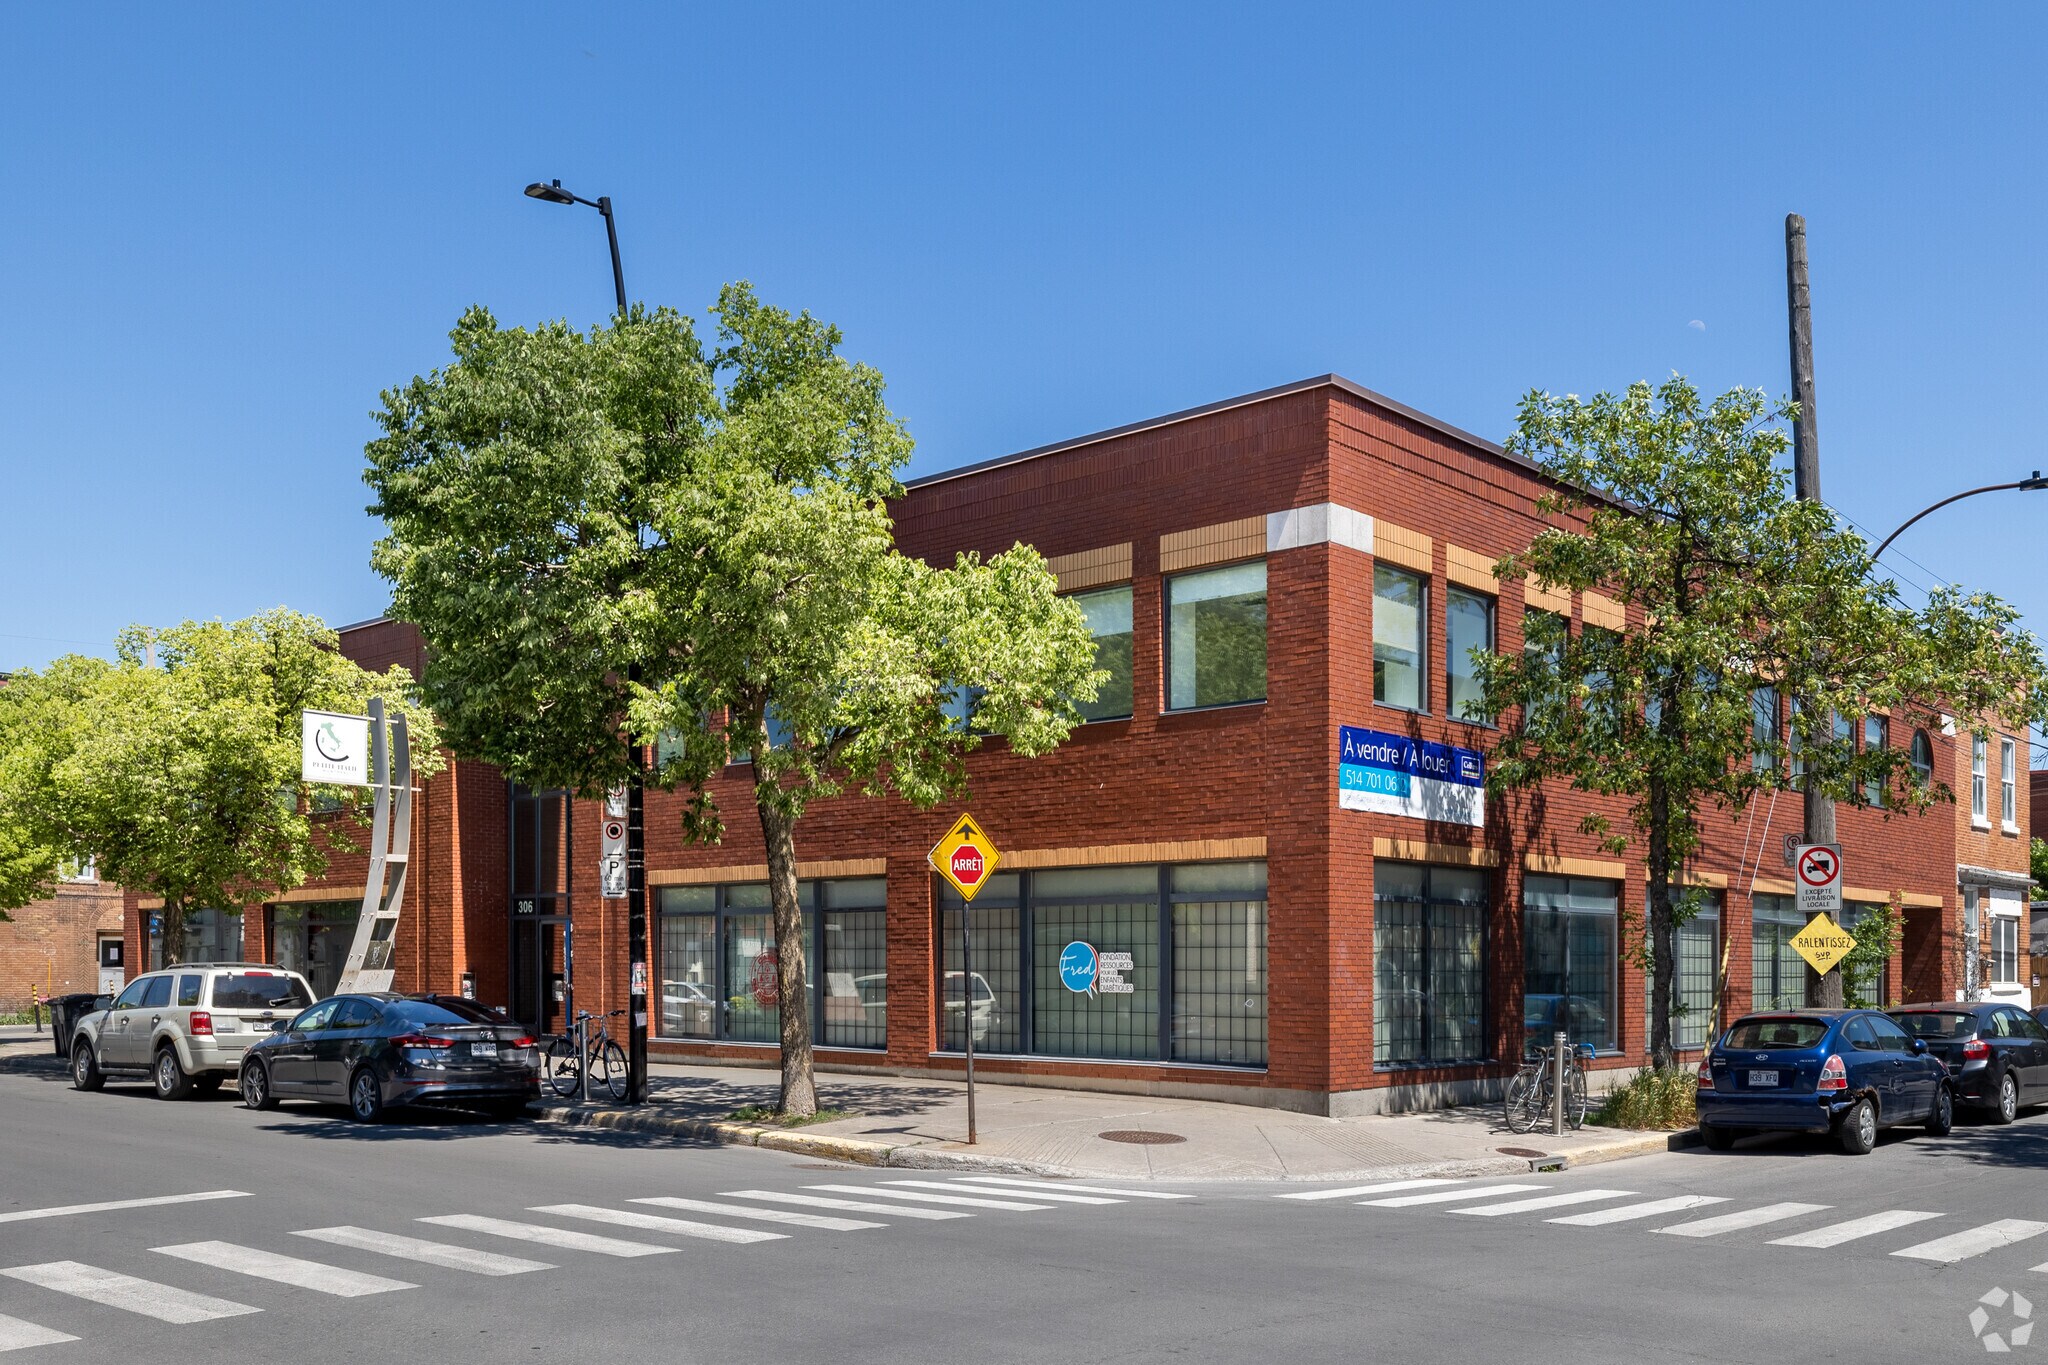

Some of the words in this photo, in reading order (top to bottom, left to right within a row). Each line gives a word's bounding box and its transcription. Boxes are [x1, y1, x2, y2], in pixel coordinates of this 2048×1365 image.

[1343, 731, 1354, 758] À
[1356, 741, 1400, 765] vendre
[1401, 746, 1408, 765] /
[1409, 743, 1419, 768] À
[1421, 751, 1451, 774] louer
[1345, 769, 1363, 786] 514
[1365, 772, 1382, 789] 701
[609, 861, 619, 875] P
[953, 856, 982, 871] ARRÊT
[1805, 887, 1832, 895] EXCEPTÉ
[1802, 894, 1836, 902] LIVRAISON
[518, 900, 533, 913] 306
[1100, 953, 1131, 961] FONDATION
[1060, 955, 1096, 977] Fred
[1100, 961, 1133, 969] RESSOURCES
